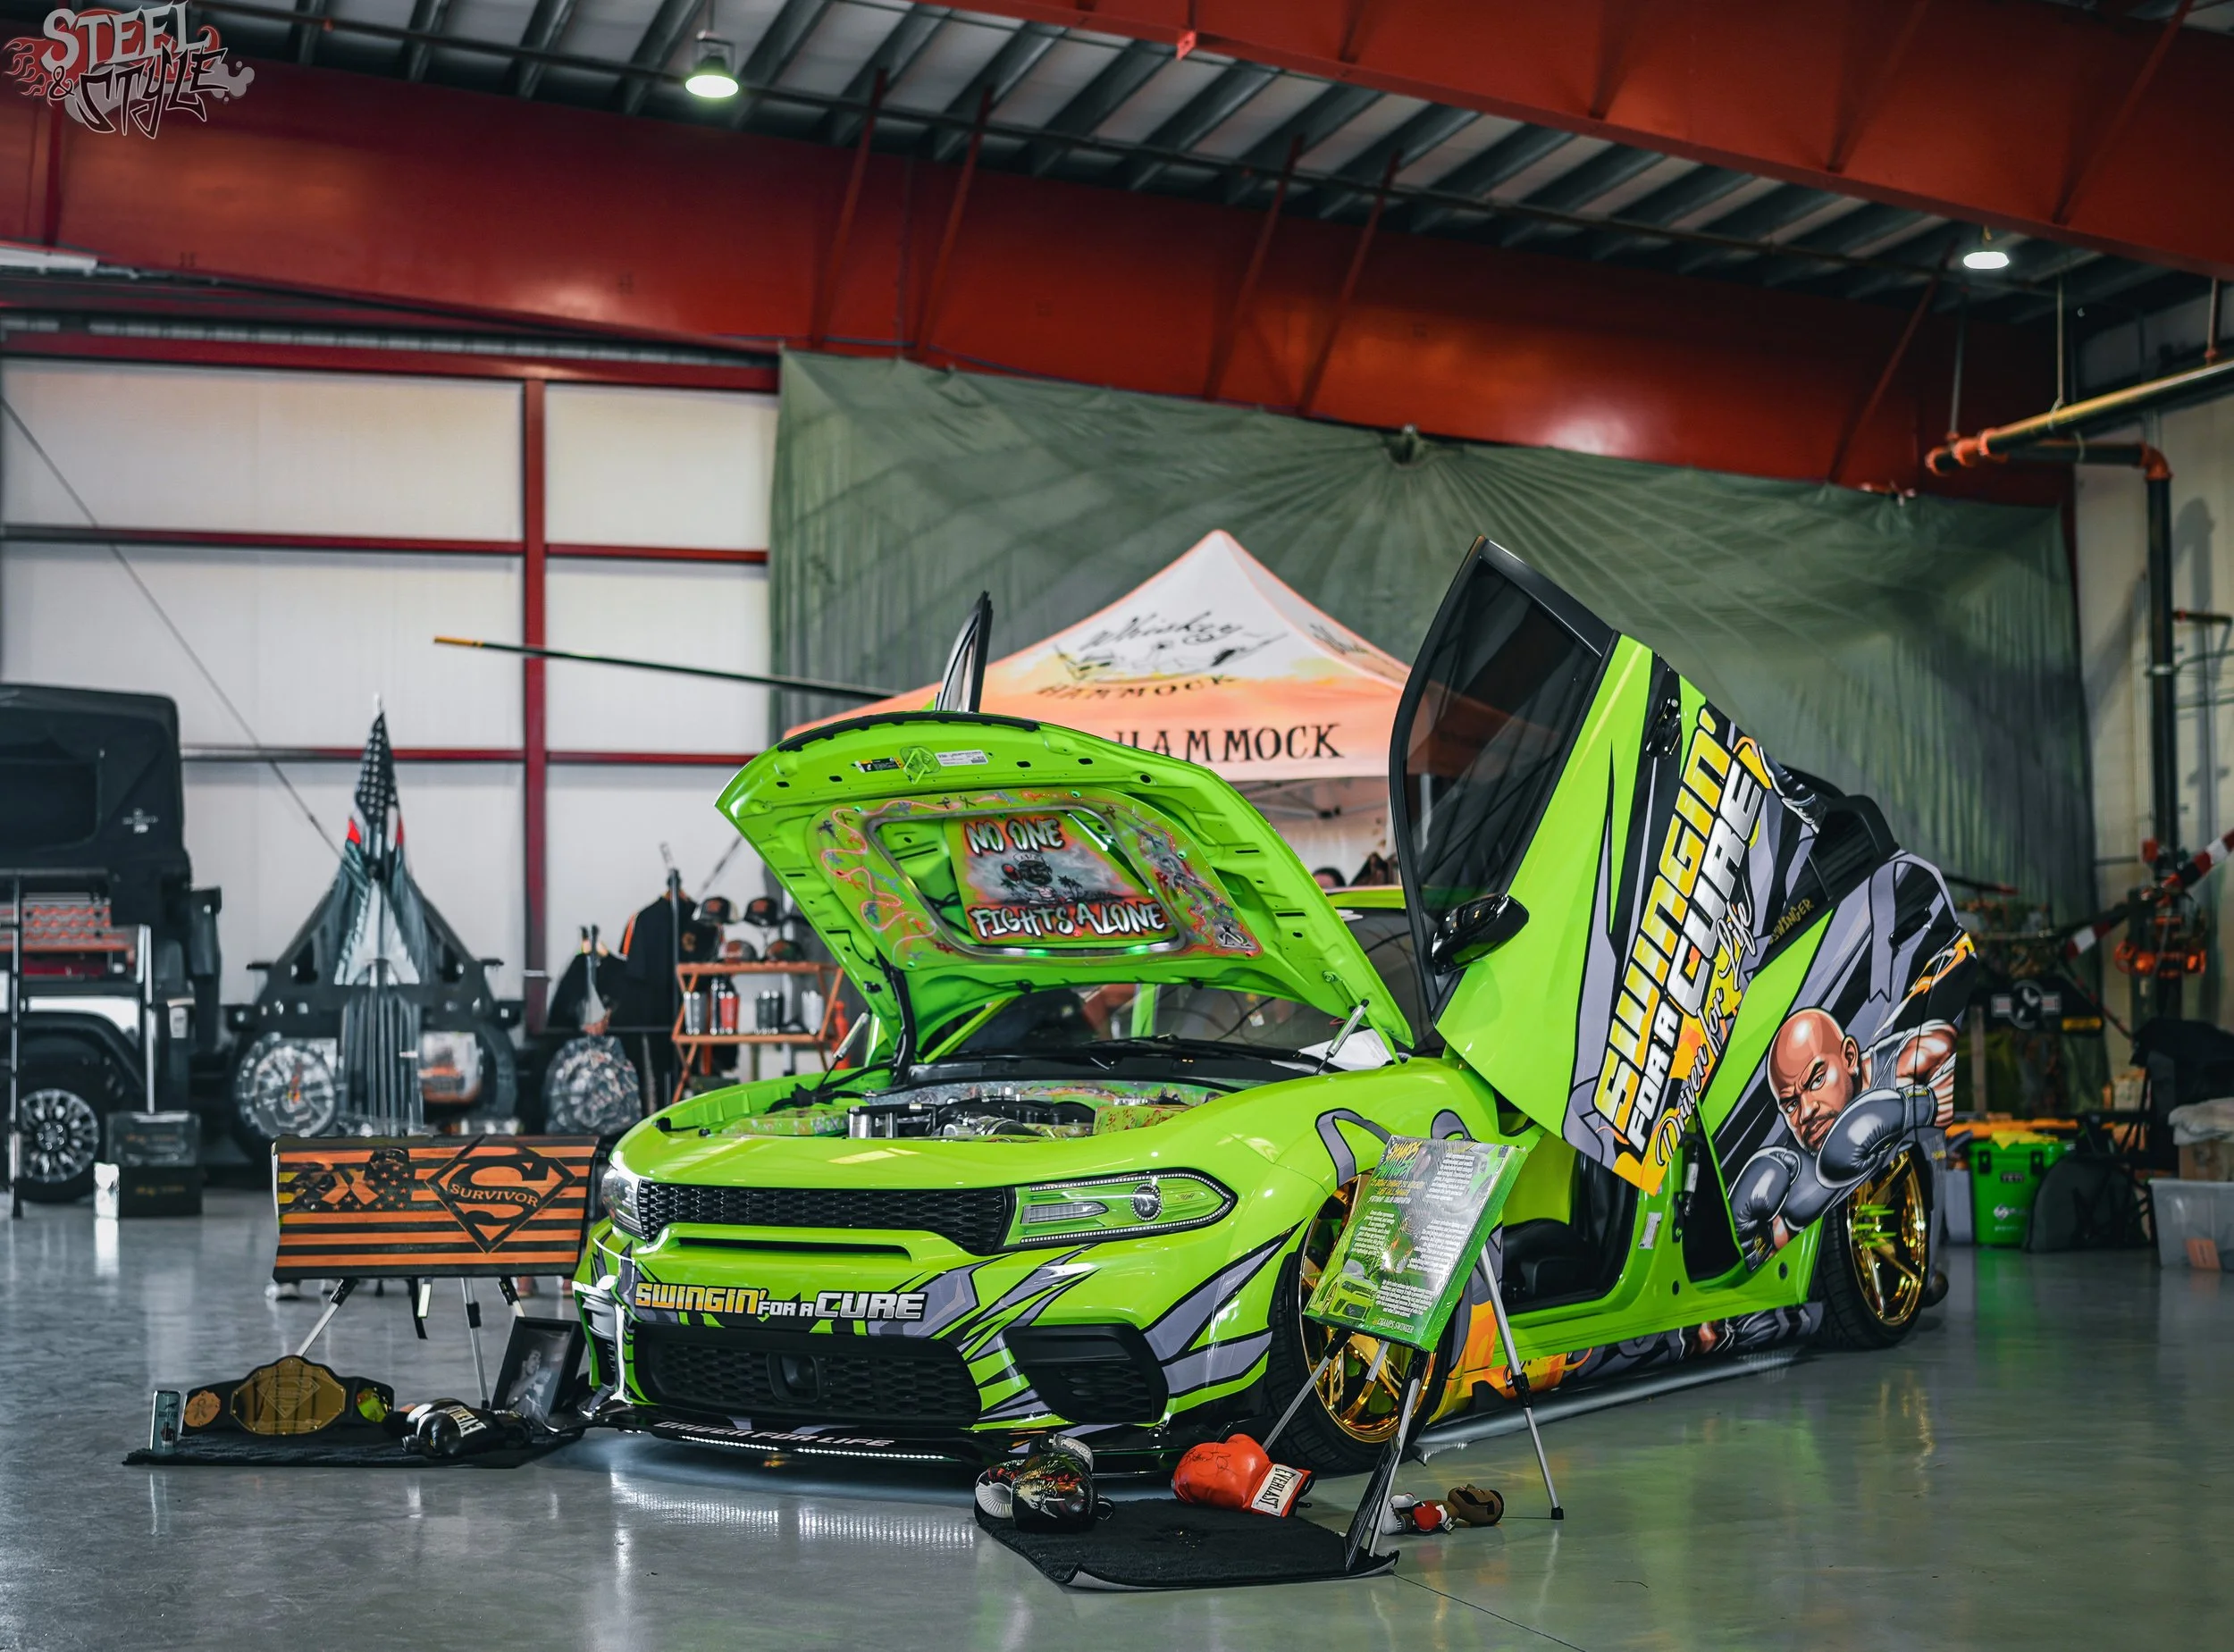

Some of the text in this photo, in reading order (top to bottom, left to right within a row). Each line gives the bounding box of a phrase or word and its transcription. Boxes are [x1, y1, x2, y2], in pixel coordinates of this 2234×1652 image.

[965, 817, 1065, 856] NO ONE
[969, 901, 1167, 940] FIGHTS ALONE
[1594, 708, 1732, 1136] SWINGIN'
[1627, 1045, 1675, 1153] FOR
[1653, 1002, 1680, 1045] A
[1655, 1044, 1710, 1168] Driven
[1698, 987, 1725, 1058] for
[449, 1182, 539, 1208] SURVIVOR
[634, 1282, 923, 1320] SWINGIN' FOR A CURE
[653, 1421, 895, 1447] DRIVEN FOR LIFE
[1259, 1467, 1297, 1509] EVERLAST
